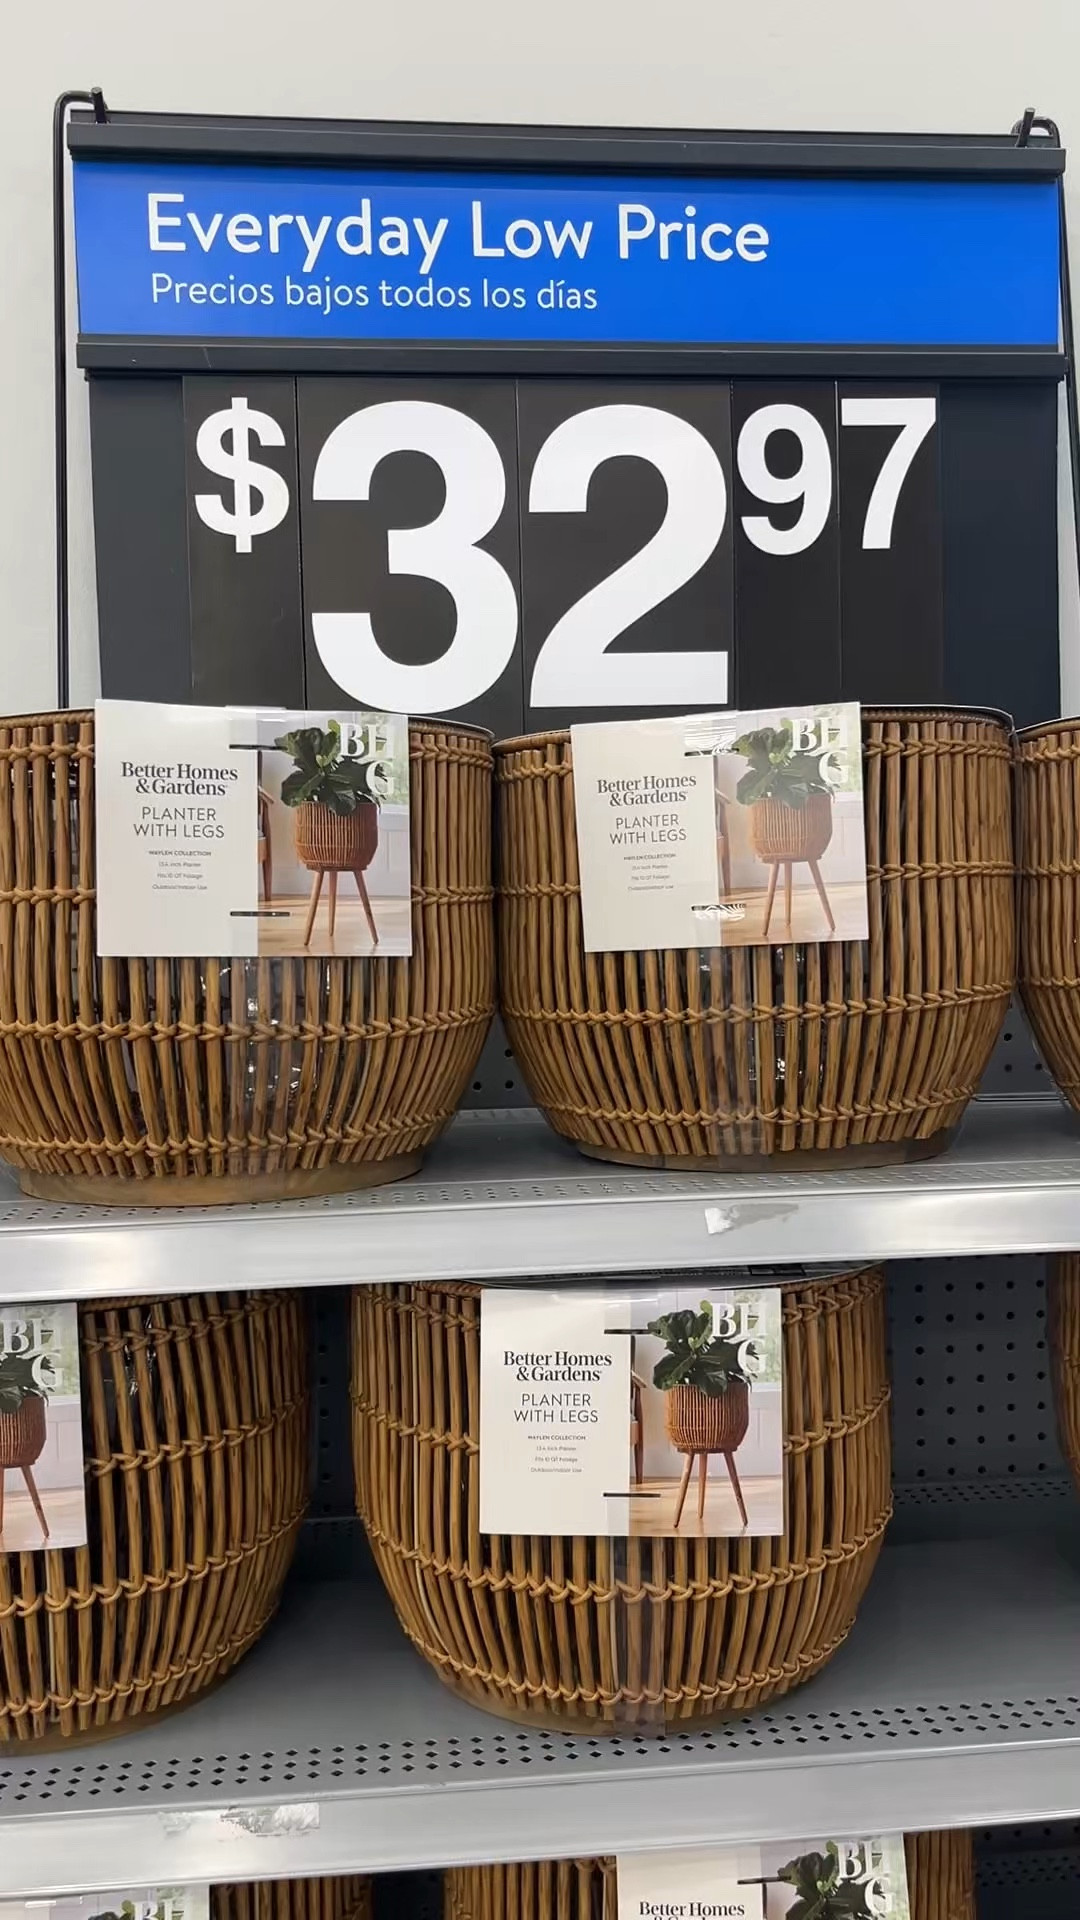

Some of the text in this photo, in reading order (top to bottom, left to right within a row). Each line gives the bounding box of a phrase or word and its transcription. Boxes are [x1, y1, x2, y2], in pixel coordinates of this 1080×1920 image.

[148, 192, 769, 275] Everyday Low Price
[151, 272, 597, 315] Precios bajos todos los días
[121, 761, 239, 781] Better Homes
[597, 775, 697, 794] Better Homes
[142, 806, 216, 821] PLANTER
[615, 813, 680, 830] PLANTER
[133, 823, 225, 839] WITH LEGS
[609, 828, 687, 845] WITH LEGS
[503, 1351, 612, 1367] Better Homes
[521, 1393, 591, 1407] PLANTER
[513, 1409, 599, 1423] WITH LEGS
[639, 1901, 745, 1917] Better Homes
